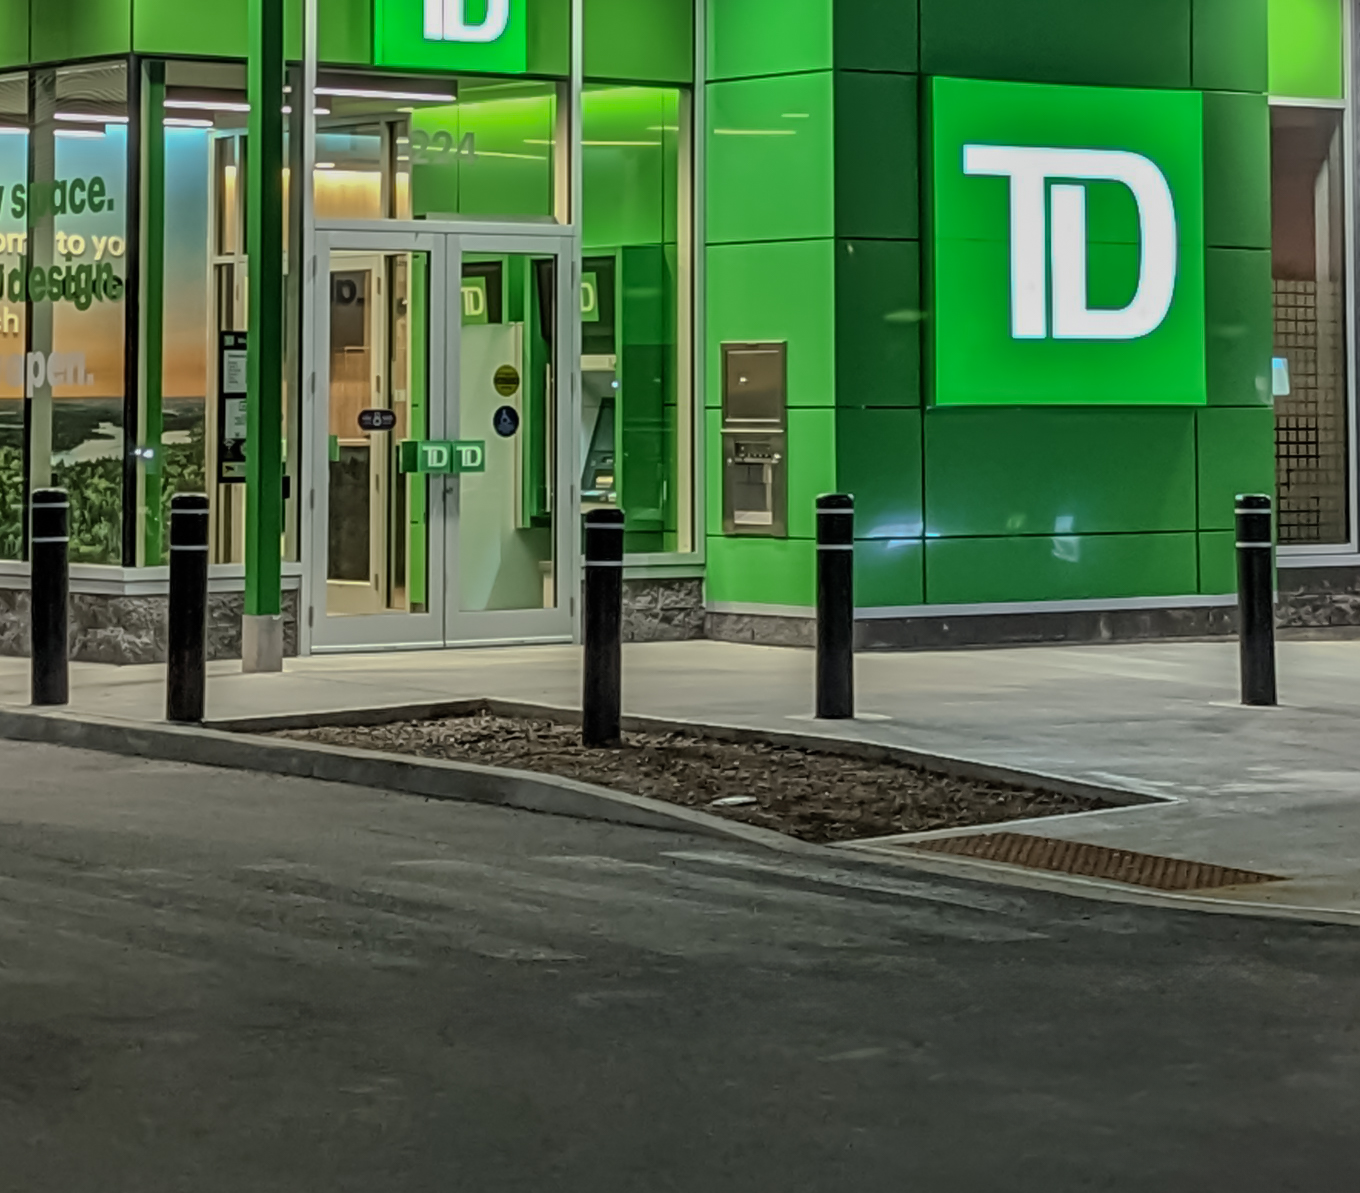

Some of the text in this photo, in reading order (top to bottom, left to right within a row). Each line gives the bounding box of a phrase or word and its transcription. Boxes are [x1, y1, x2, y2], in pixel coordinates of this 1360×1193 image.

[409, 129, 478, 165] 224
[963, 143, 1177, 339] TD
[422, 446, 448, 467] TD
[456, 446, 482, 467] TD
